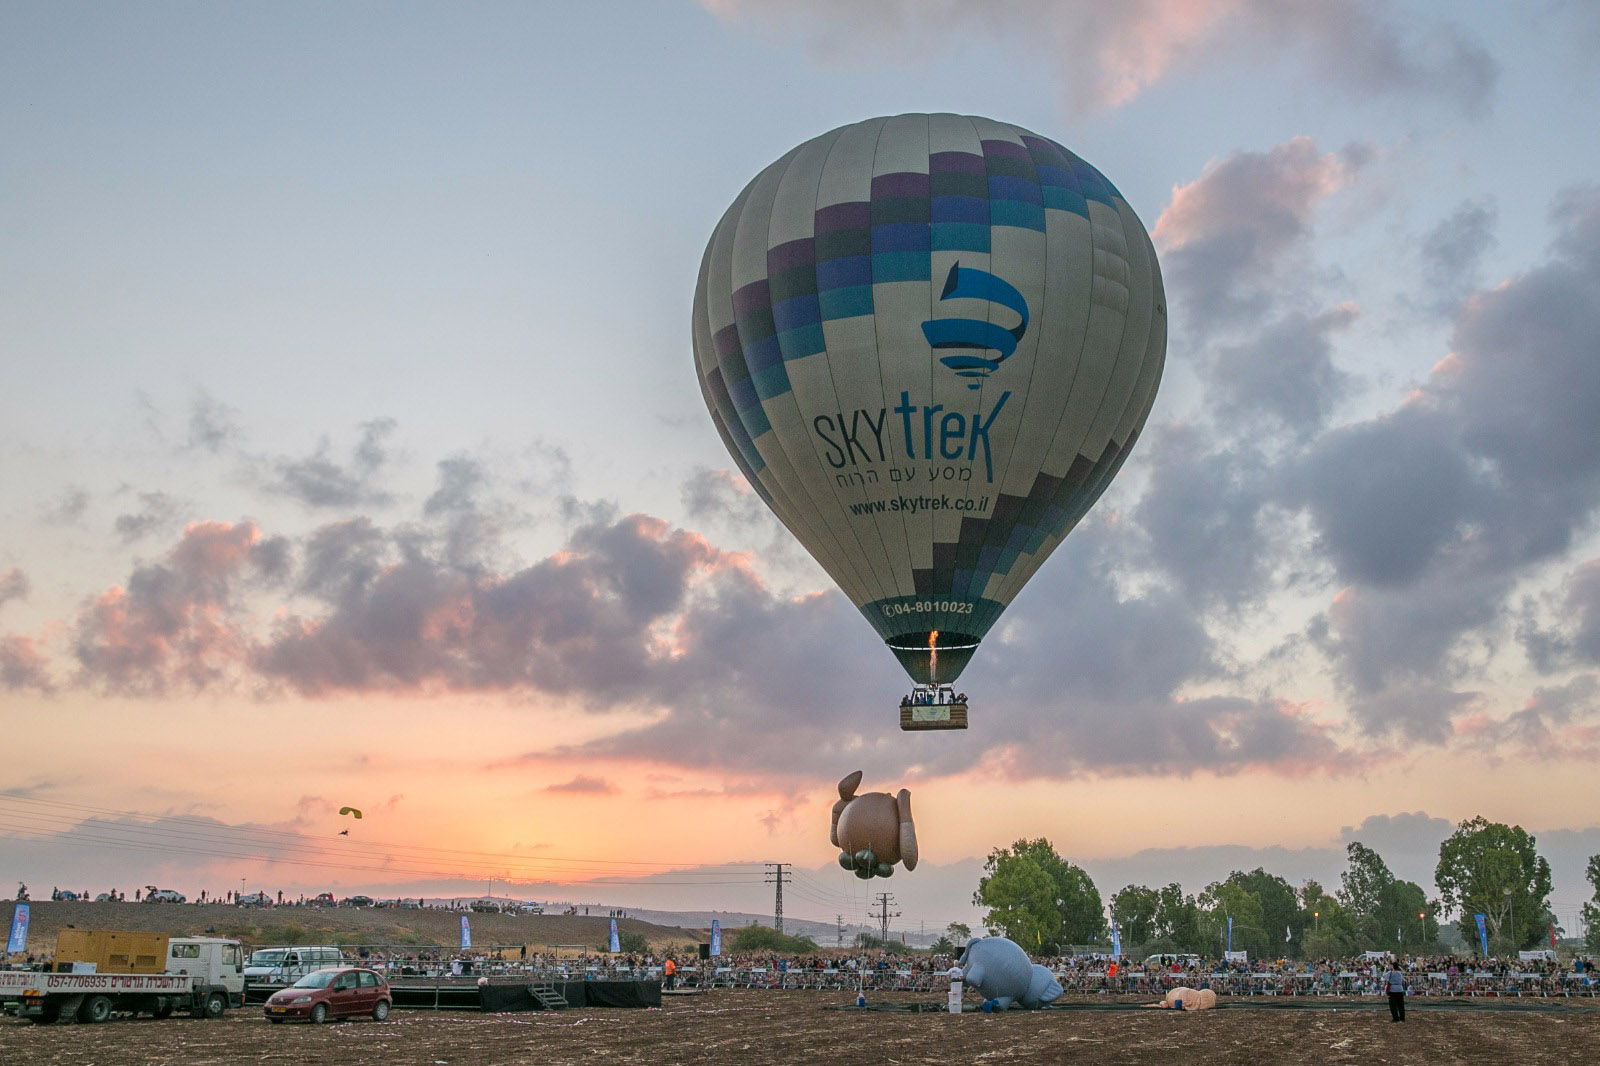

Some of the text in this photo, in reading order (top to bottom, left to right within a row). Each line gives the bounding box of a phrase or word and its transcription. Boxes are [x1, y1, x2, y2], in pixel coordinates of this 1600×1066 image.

[836, 466, 972, 489] מסע עם הרוח
[849, 494, 989, 516] www.skytrek.co.il
[895, 601, 974, 615] 04-8010023
[47, 975, 107, 988] 057-7706935
